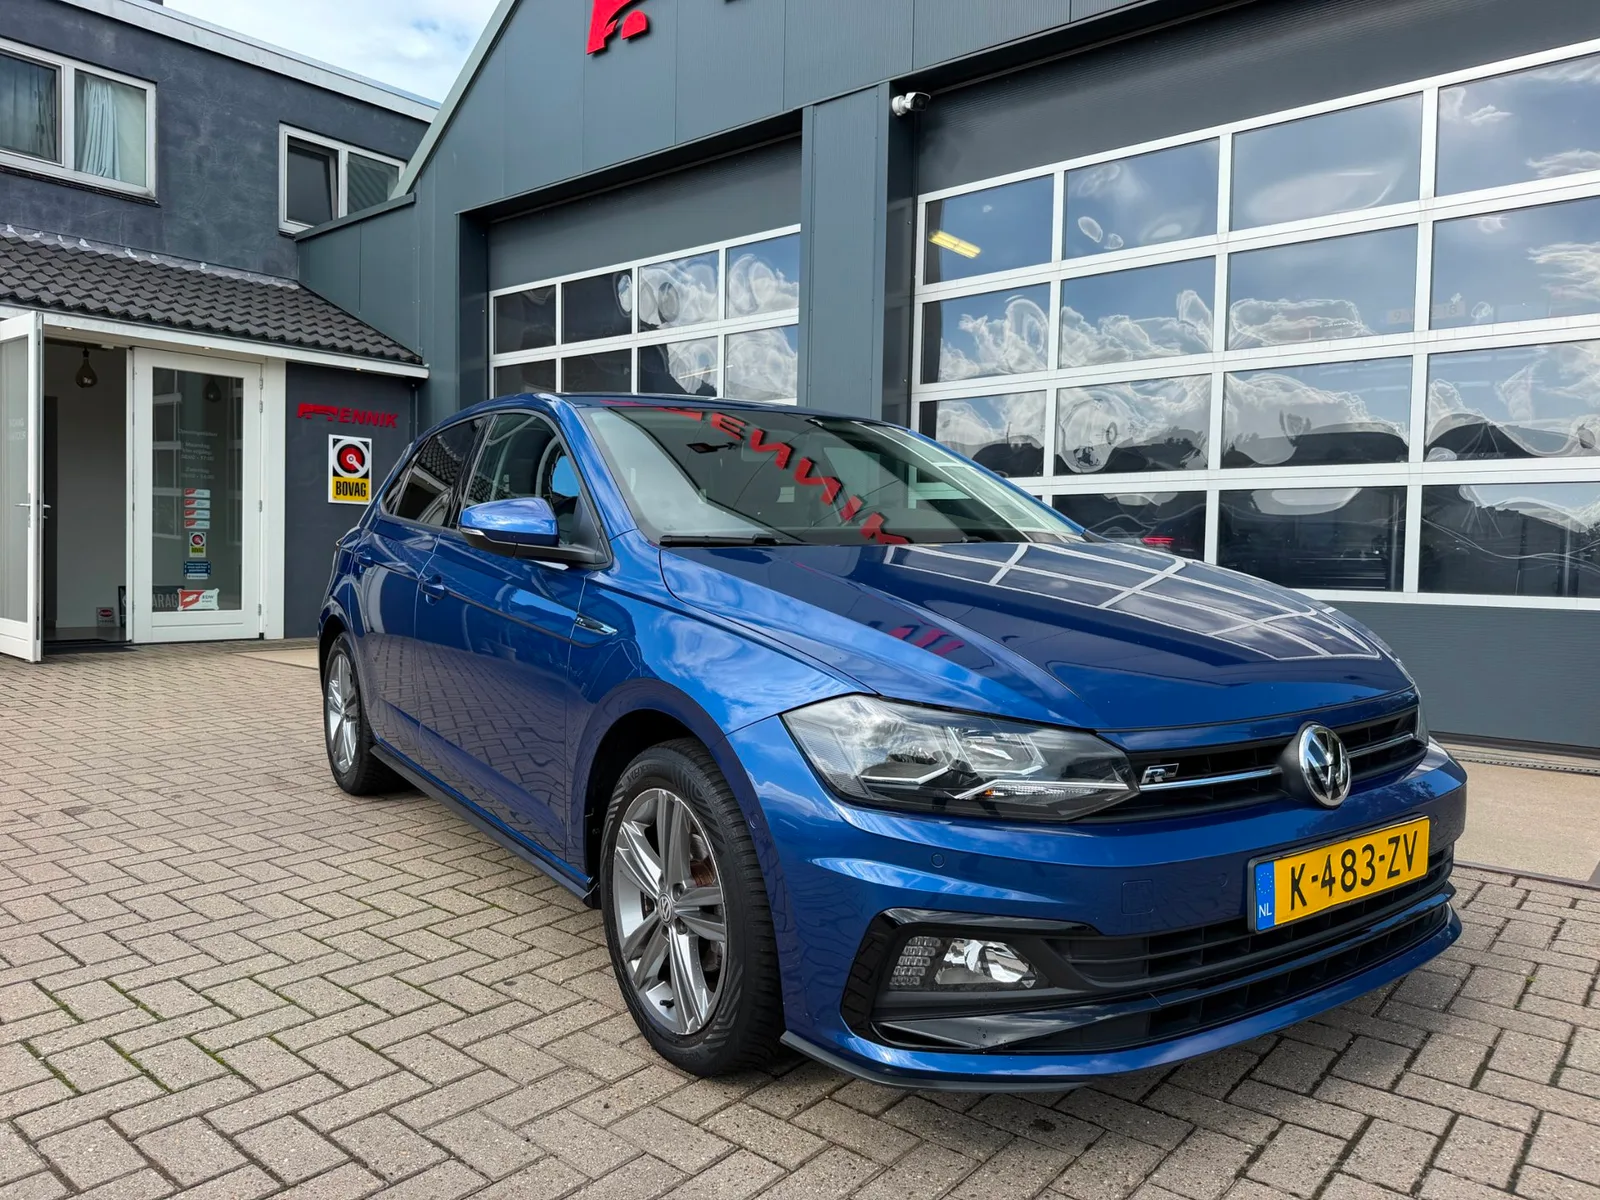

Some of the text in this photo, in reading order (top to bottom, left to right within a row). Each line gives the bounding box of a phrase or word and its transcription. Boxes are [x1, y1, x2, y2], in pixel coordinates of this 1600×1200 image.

[335, 480, 367, 497] BOVAG
[1290, 830, 1418, 911] K-483-ZV
[1258, 902, 1272, 918] NL
